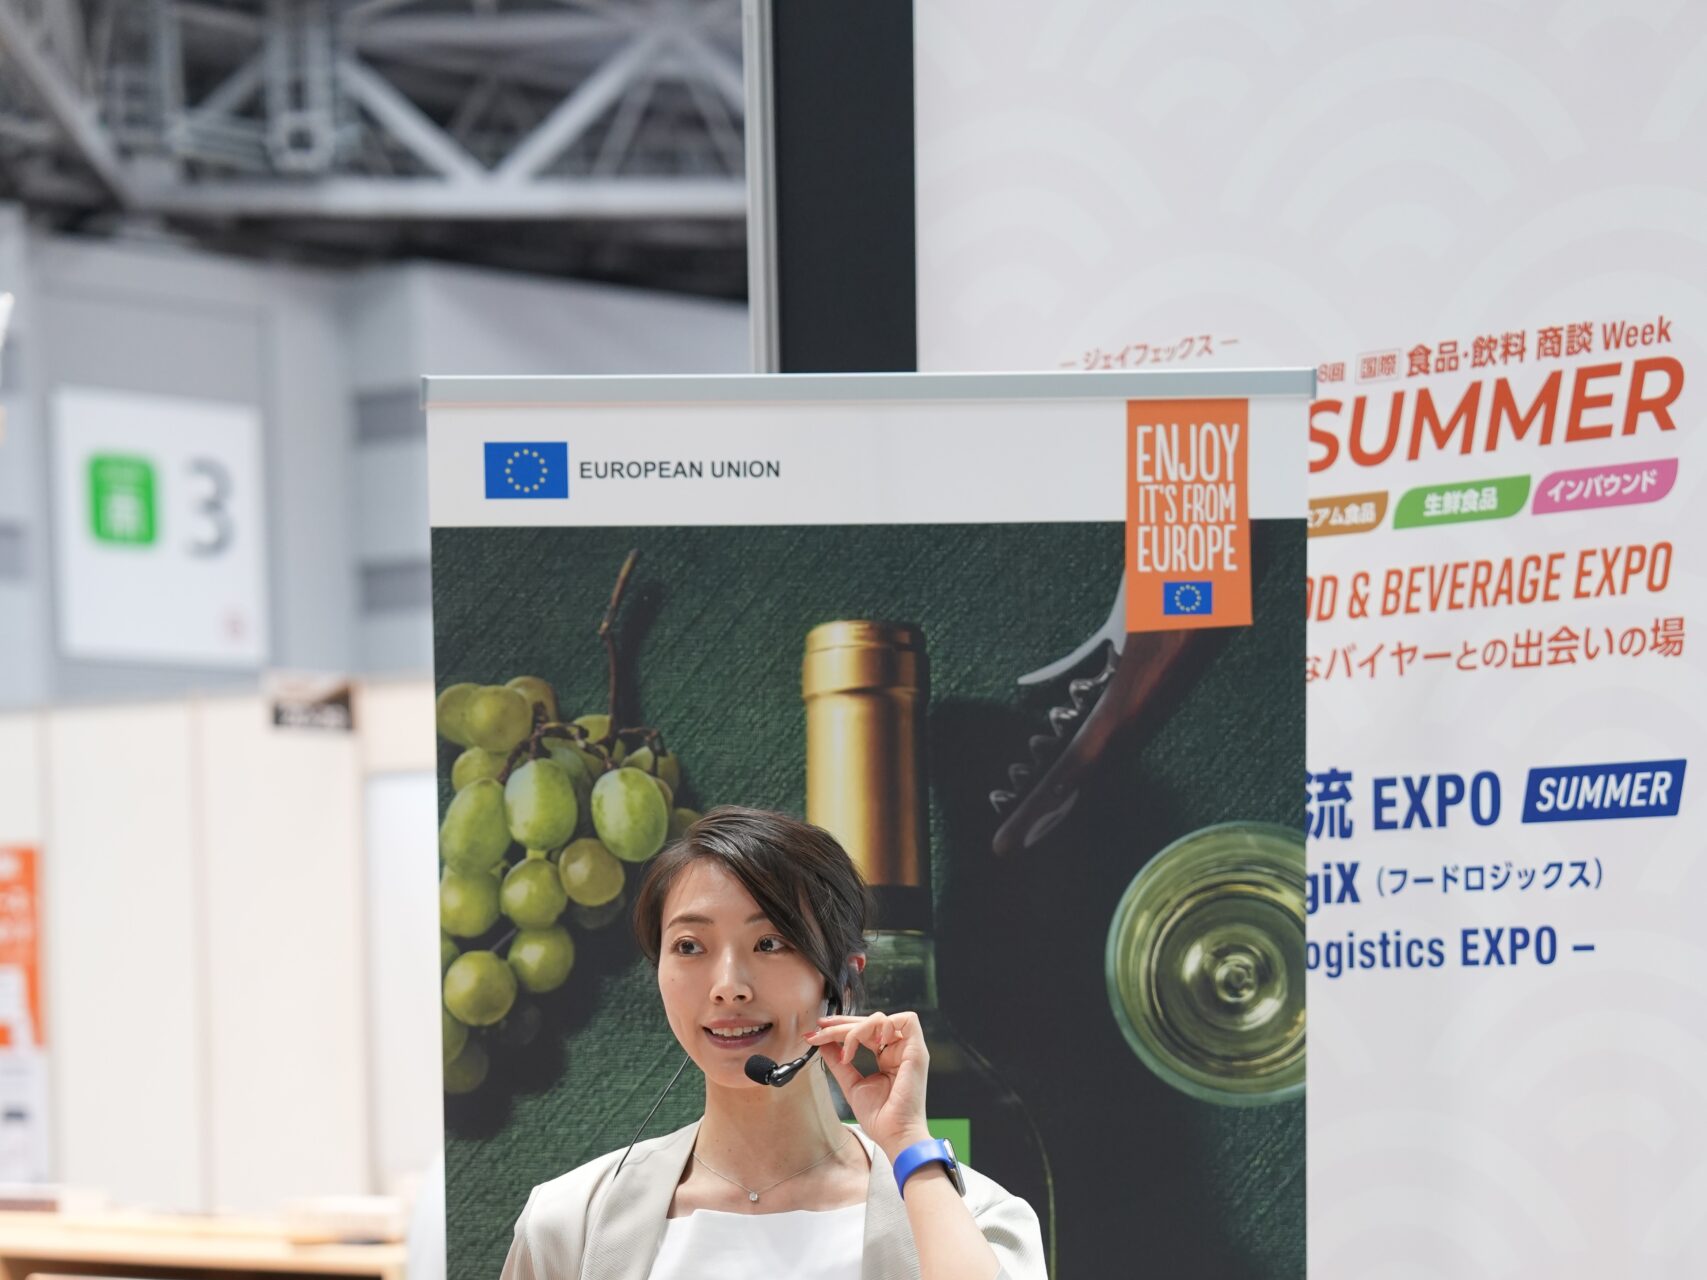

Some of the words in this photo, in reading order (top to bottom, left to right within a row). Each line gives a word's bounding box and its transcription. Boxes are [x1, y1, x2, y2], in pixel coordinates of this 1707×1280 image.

[1083, 334, 1213, 370] ジェイフェックス
[1361, 354, 1397, 379] 国際
[1537, 322, 1593, 360] 商談
[1602, 315, 1672, 350] Week
[1308, 356, 1686, 473] SUMMER
[580, 461, 703, 479] EUROPEAN
[711, 460, 780, 479] UNION
[1136, 422, 1240, 483] ENJOY
[185, 456, 233, 558] 3
[1138, 484, 1178, 524] IT'S
[1182, 483, 1236, 523] FROM
[1424, 487, 1498, 517] 生鮮食品
[1547, 469, 1658, 503] インバウンド
[1137, 524, 1238, 573] EUROPE
[1348, 571, 1371, 620] &
[1381, 550, 1566, 617] BEVERAGE
[1573, 540, 1674, 600] EXPO
[1306, 768, 1353, 840] 流
[1373, 771, 1501, 831] EXPO
[1535, 770, 1674, 814] SUMMER
[1306, 931, 1446, 980] ogistics
[1460, 926, 1558, 967] EXPO
